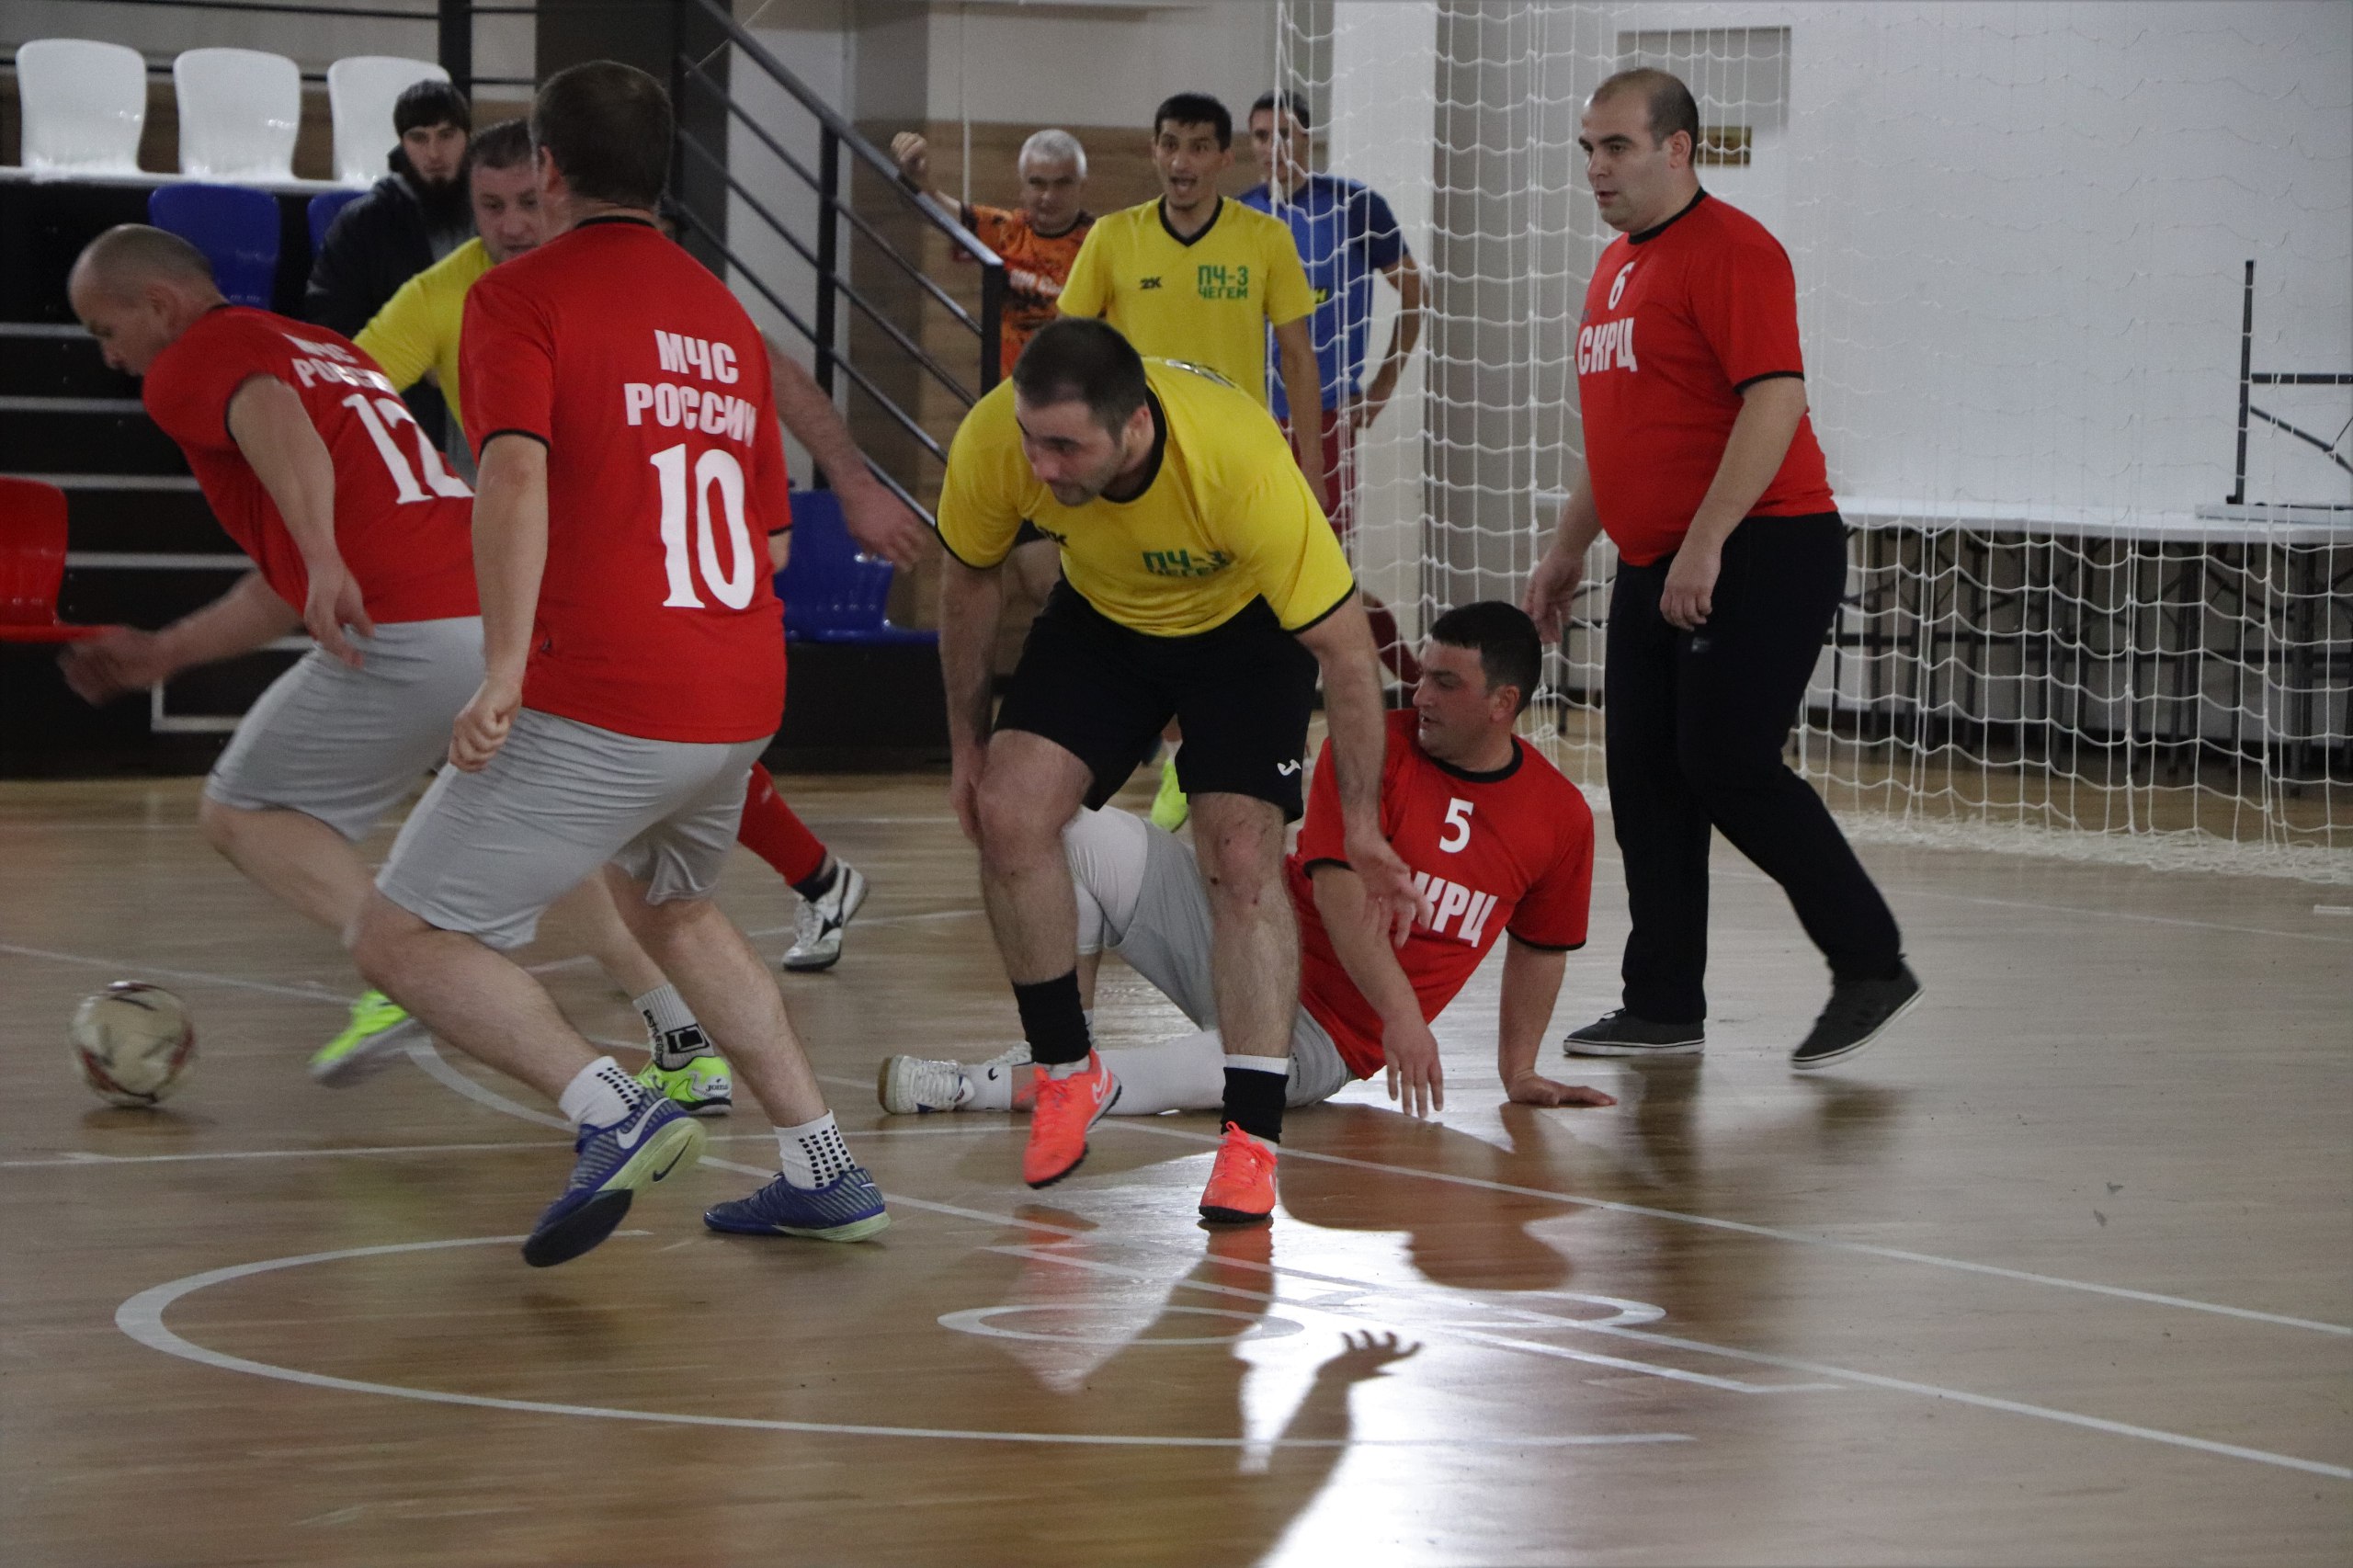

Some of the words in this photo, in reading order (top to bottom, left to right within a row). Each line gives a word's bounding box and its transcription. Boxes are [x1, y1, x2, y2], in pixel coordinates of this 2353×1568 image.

[1198, 265, 1249, 286] ПЧ-3
[1198, 286, 1249, 300] ЧЕГЕМ
[1608, 261, 1636, 311] 6
[654, 329, 739, 384] МЧС
[1577, 316, 1639, 376] СКРЦ
[624, 382, 757, 448] РОССИИ
[342, 393, 477, 505] 12
[650, 443, 756, 610] 10
[1438, 797, 1474, 854] 5
[1413, 870, 1499, 949] КРЦ
